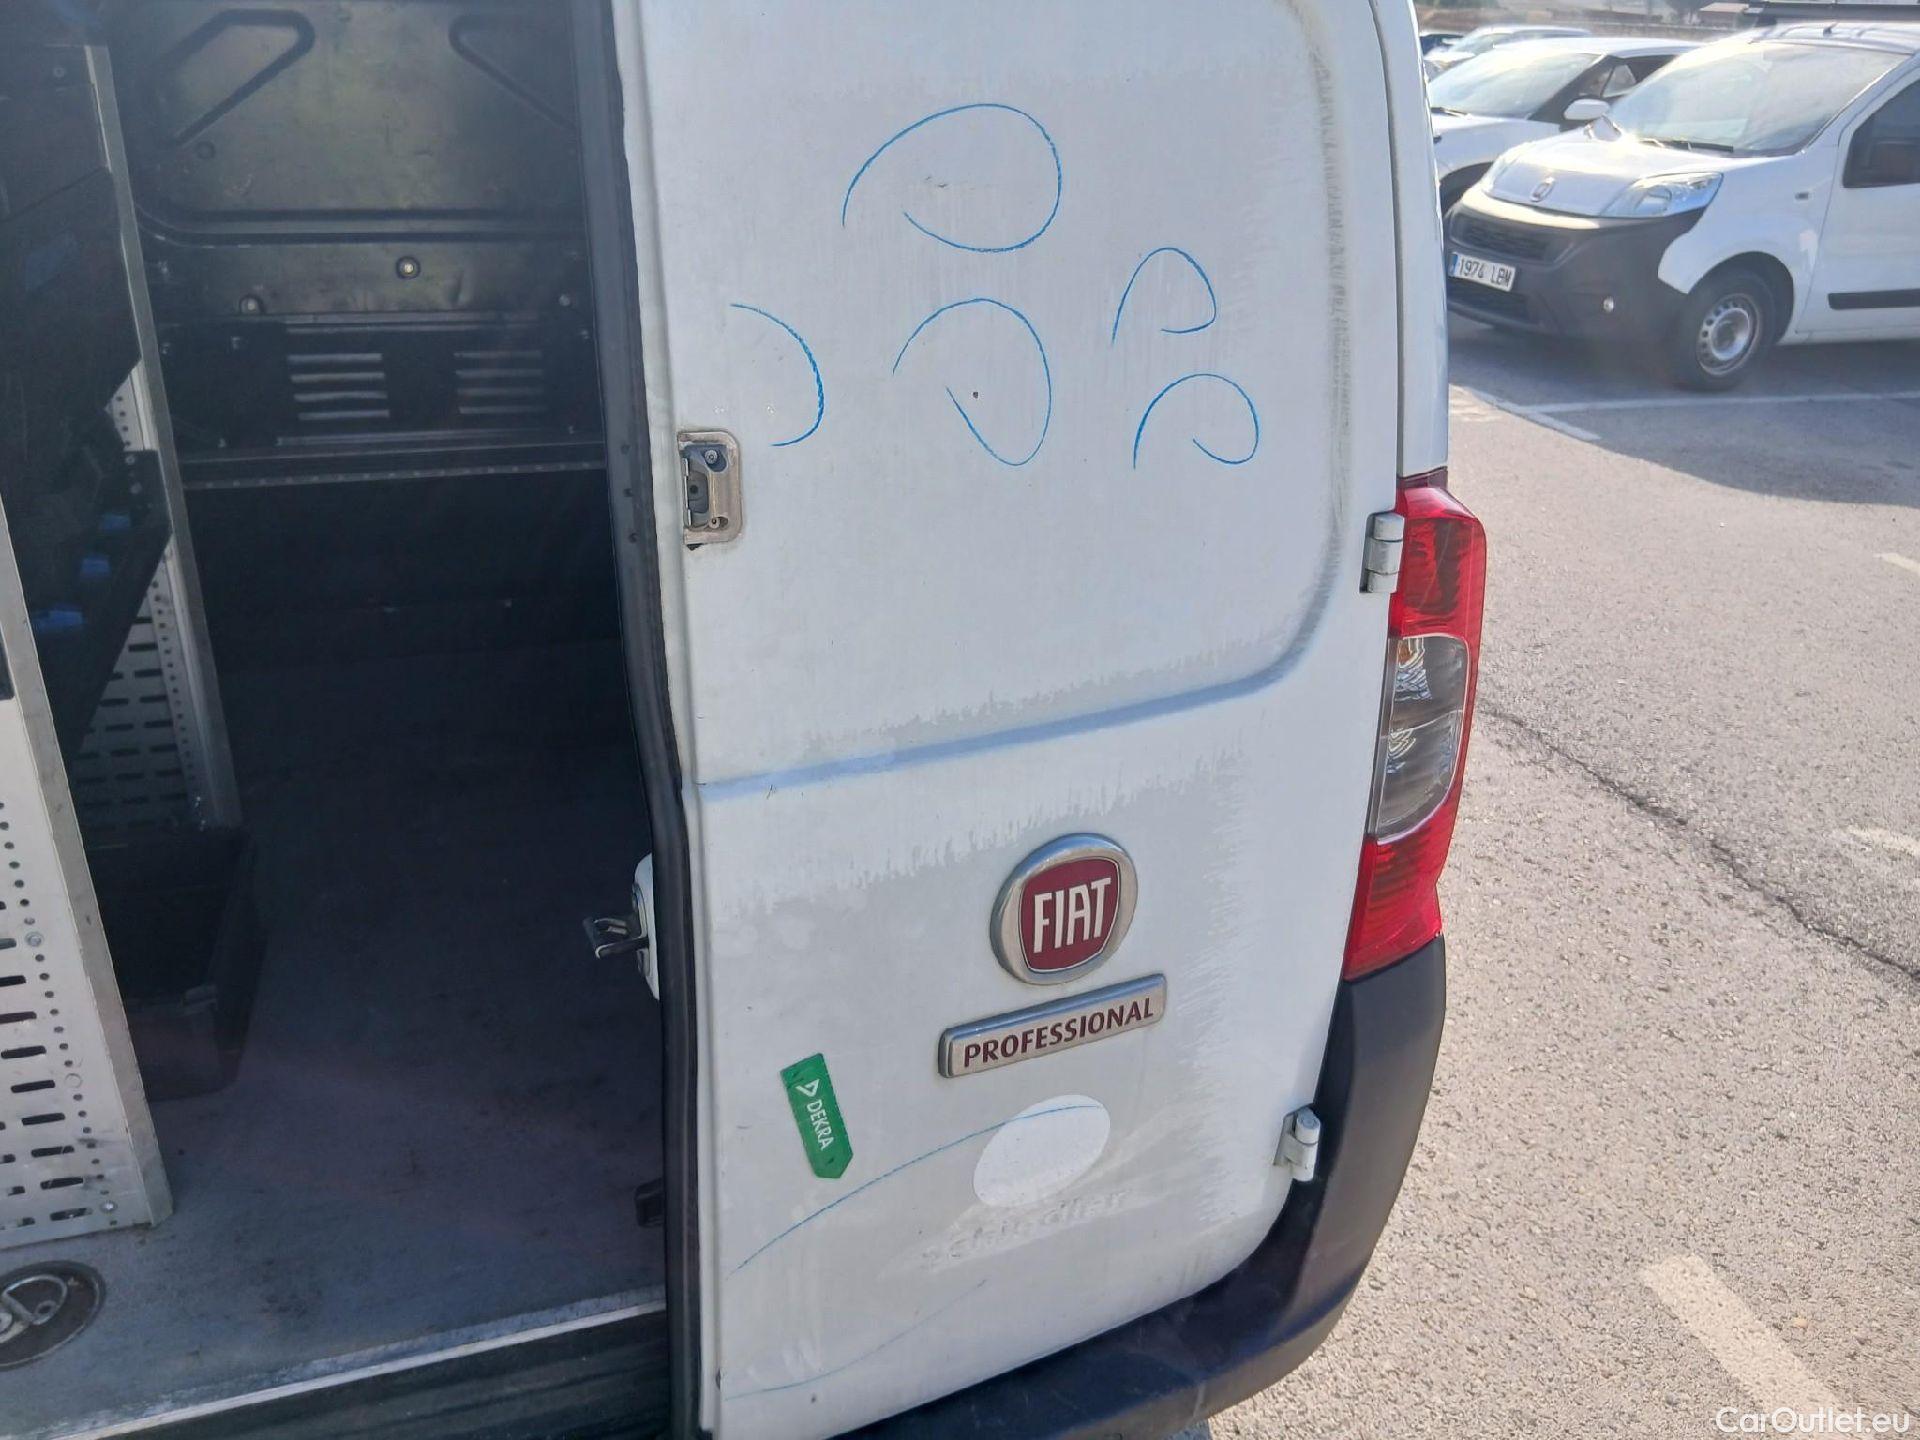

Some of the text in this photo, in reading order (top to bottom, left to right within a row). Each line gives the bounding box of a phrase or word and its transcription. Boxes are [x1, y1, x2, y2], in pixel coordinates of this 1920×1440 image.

[1033, 877, 1111, 954] FIAT
[964, 998, 1154, 1068] PROFESSIONAL
[806, 1099, 835, 1151] DEKRA
